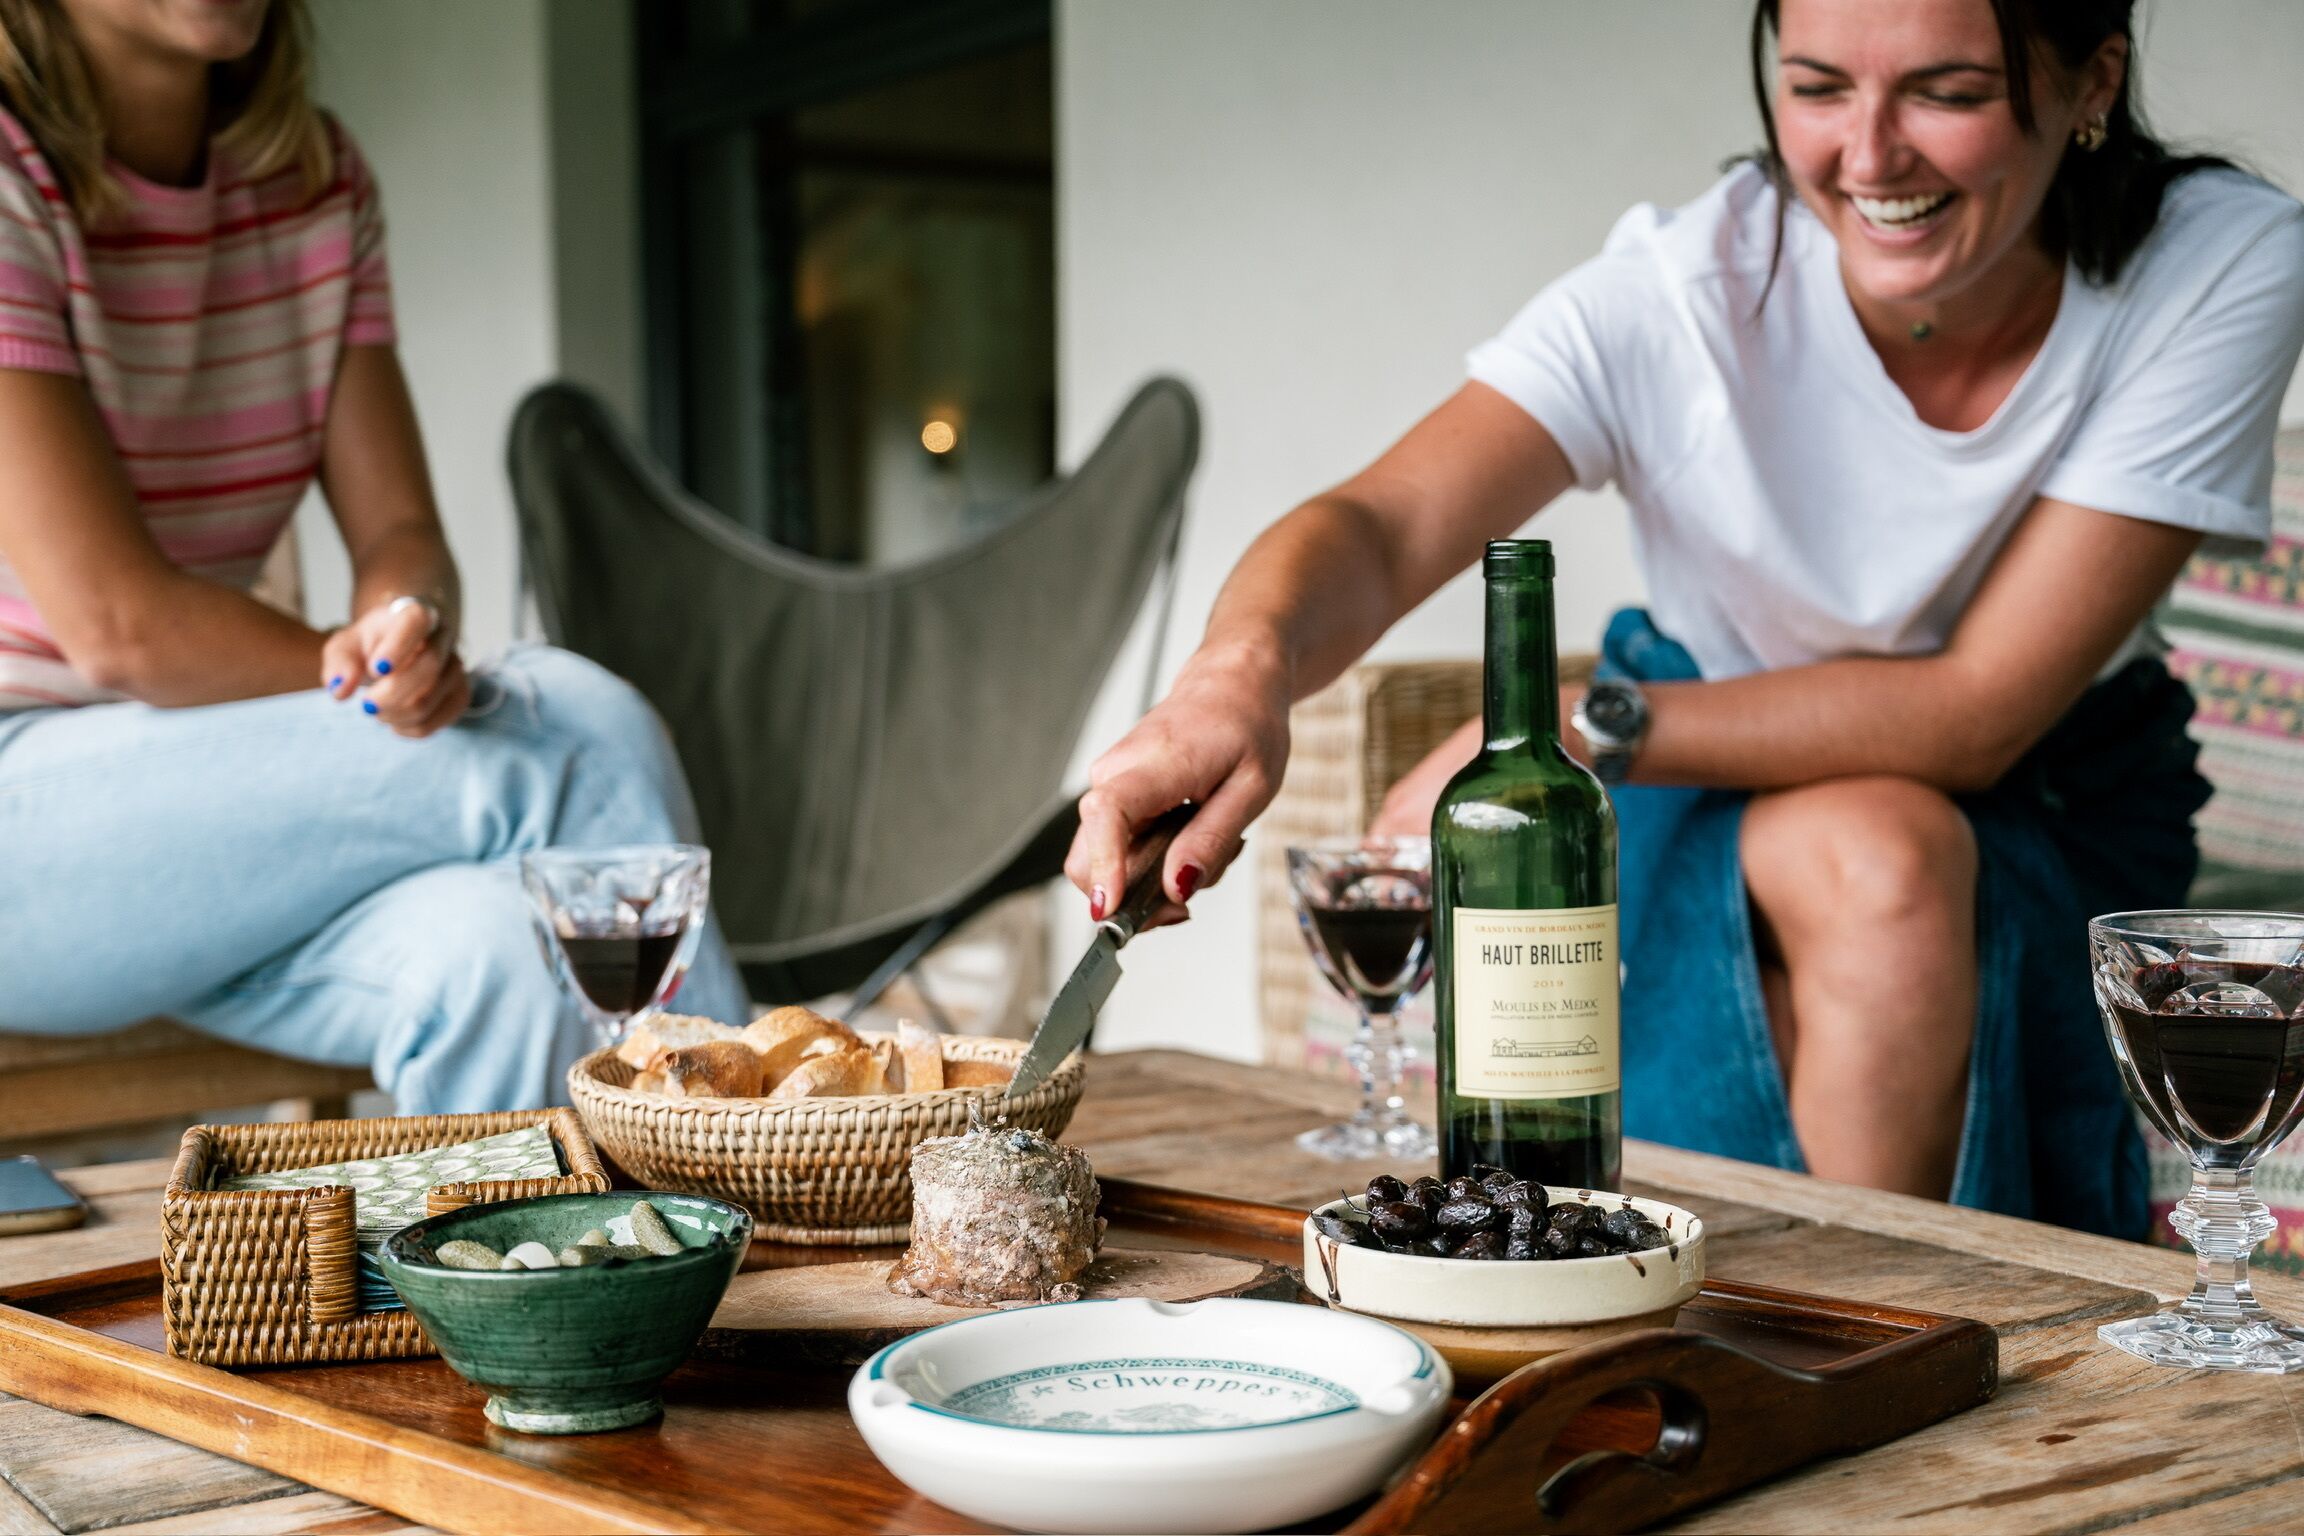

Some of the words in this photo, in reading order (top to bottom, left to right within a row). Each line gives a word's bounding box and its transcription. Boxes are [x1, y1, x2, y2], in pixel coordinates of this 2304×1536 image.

[1482, 944, 1523, 965] HAUT
[1530, 941, 1603, 965] BRILLETTE
[1533, 979, 1565, 989] 2019
[1491, 999, 1539, 1012] MOULIS
[1542, 1001, 1557, 1012] EN
[1067, 1373, 1281, 1398] Schweppes
